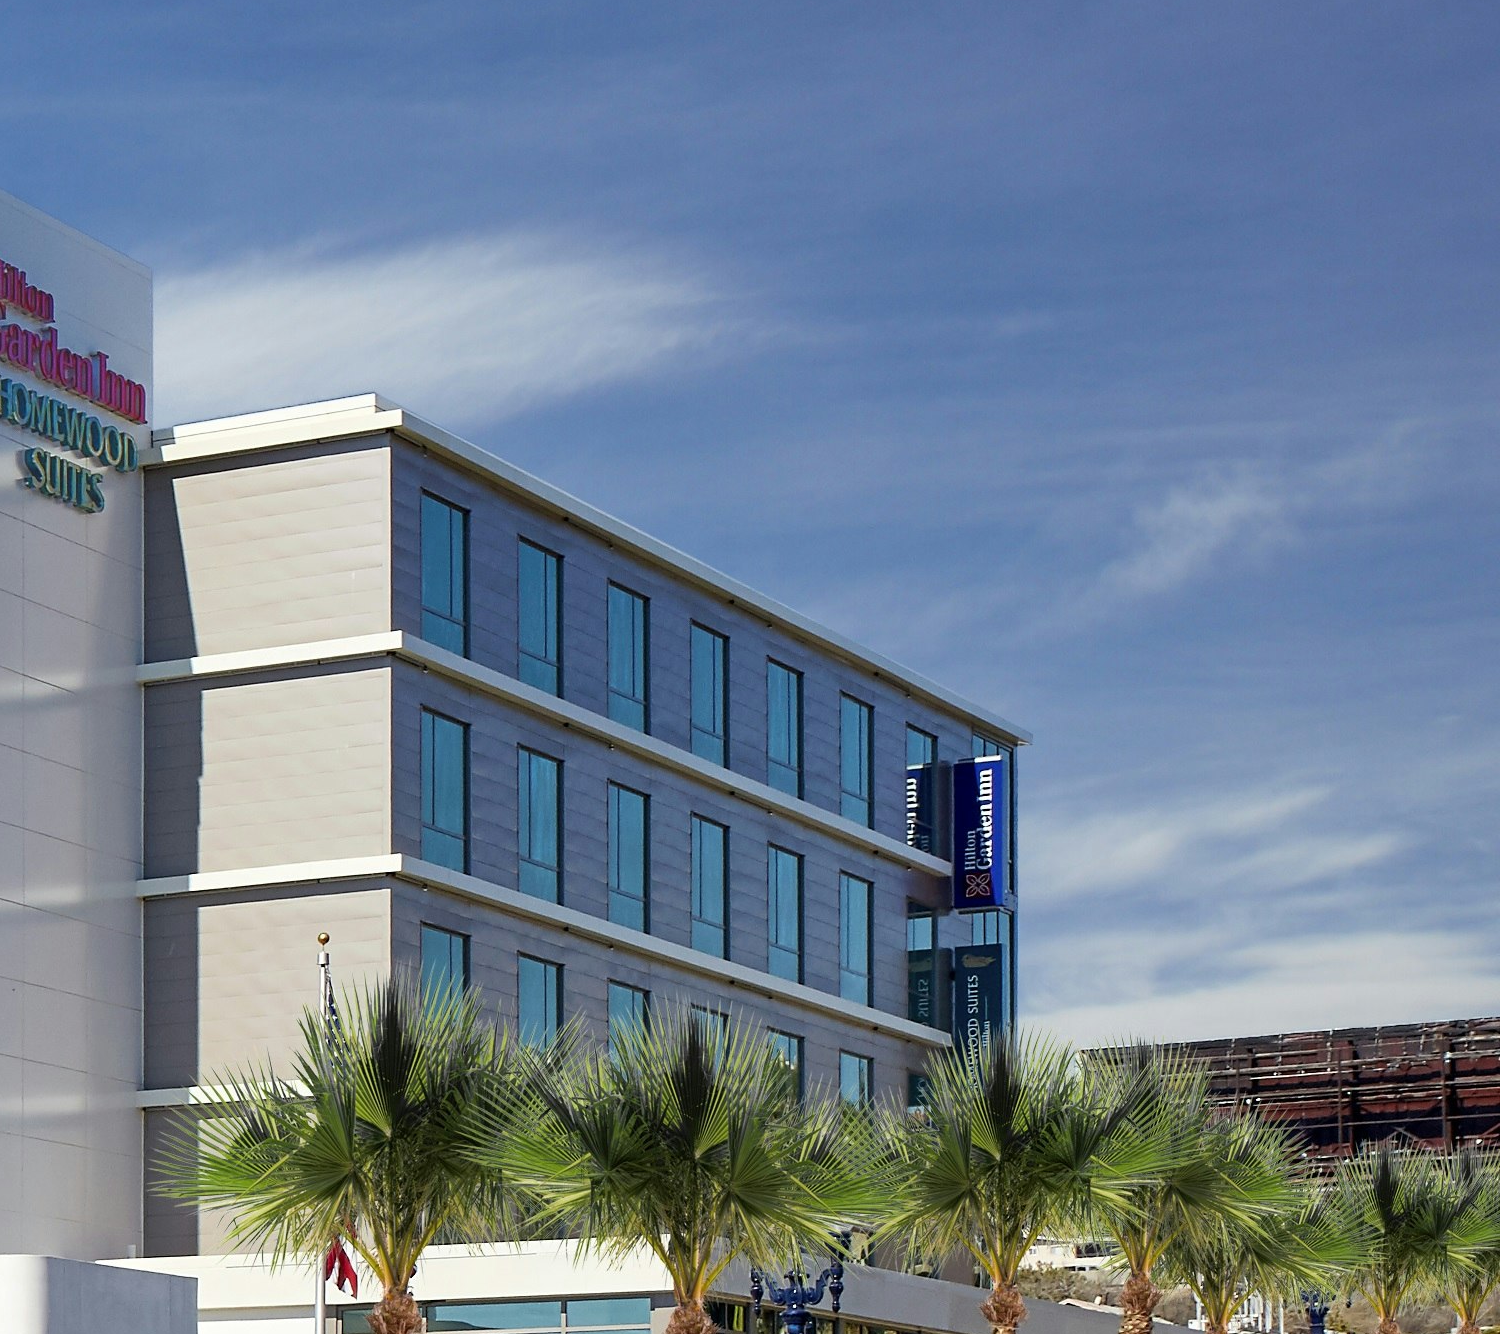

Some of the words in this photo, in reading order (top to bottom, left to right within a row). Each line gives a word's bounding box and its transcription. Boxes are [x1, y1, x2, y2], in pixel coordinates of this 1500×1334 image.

[91, 351, 147, 424] Inn
[25, 447, 105, 513] SUITES
[978, 768, 992, 801] Inn
[965, 831, 976, 870] Hilton
[977, 802, 992, 869] Garden
[968, 975, 979, 1013] SUITES
